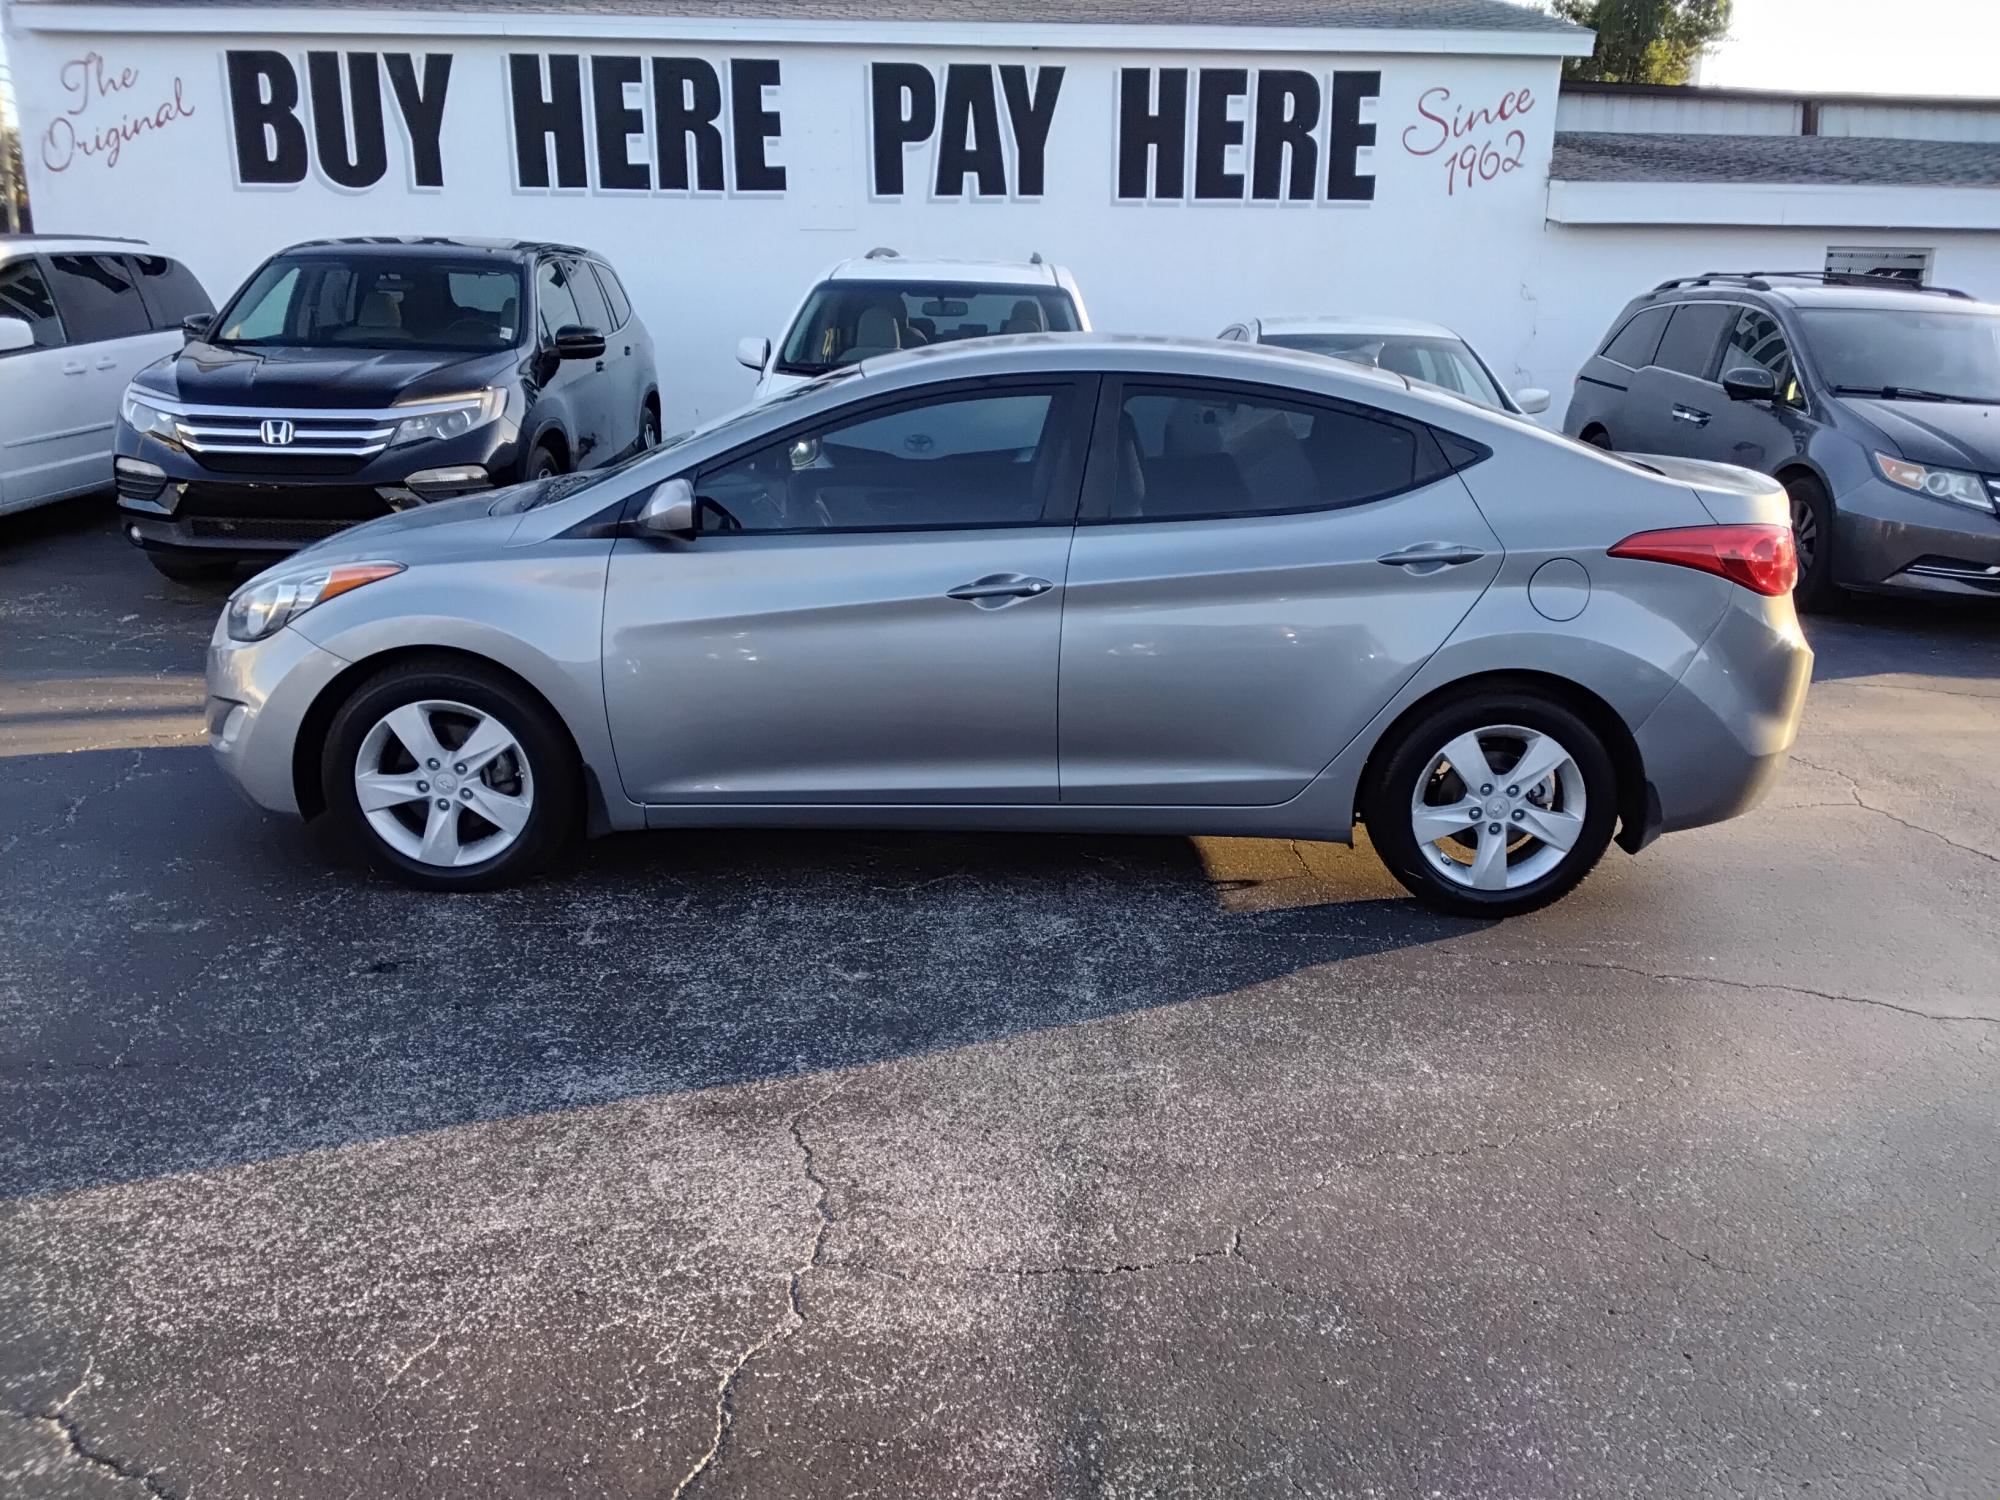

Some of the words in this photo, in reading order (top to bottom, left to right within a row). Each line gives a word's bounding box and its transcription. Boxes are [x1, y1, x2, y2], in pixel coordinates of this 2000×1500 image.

[60, 51, 139, 115] The
[42, 76, 195, 172] Original
[226, 50, 453, 188] BUY
[508, 53, 787, 191] HERE
[871, 61, 1066, 196] PAY
[1118, 67, 1382, 201] HERE
[1402, 86, 1535, 156] Since
[1444, 129, 1525, 196] 1962
